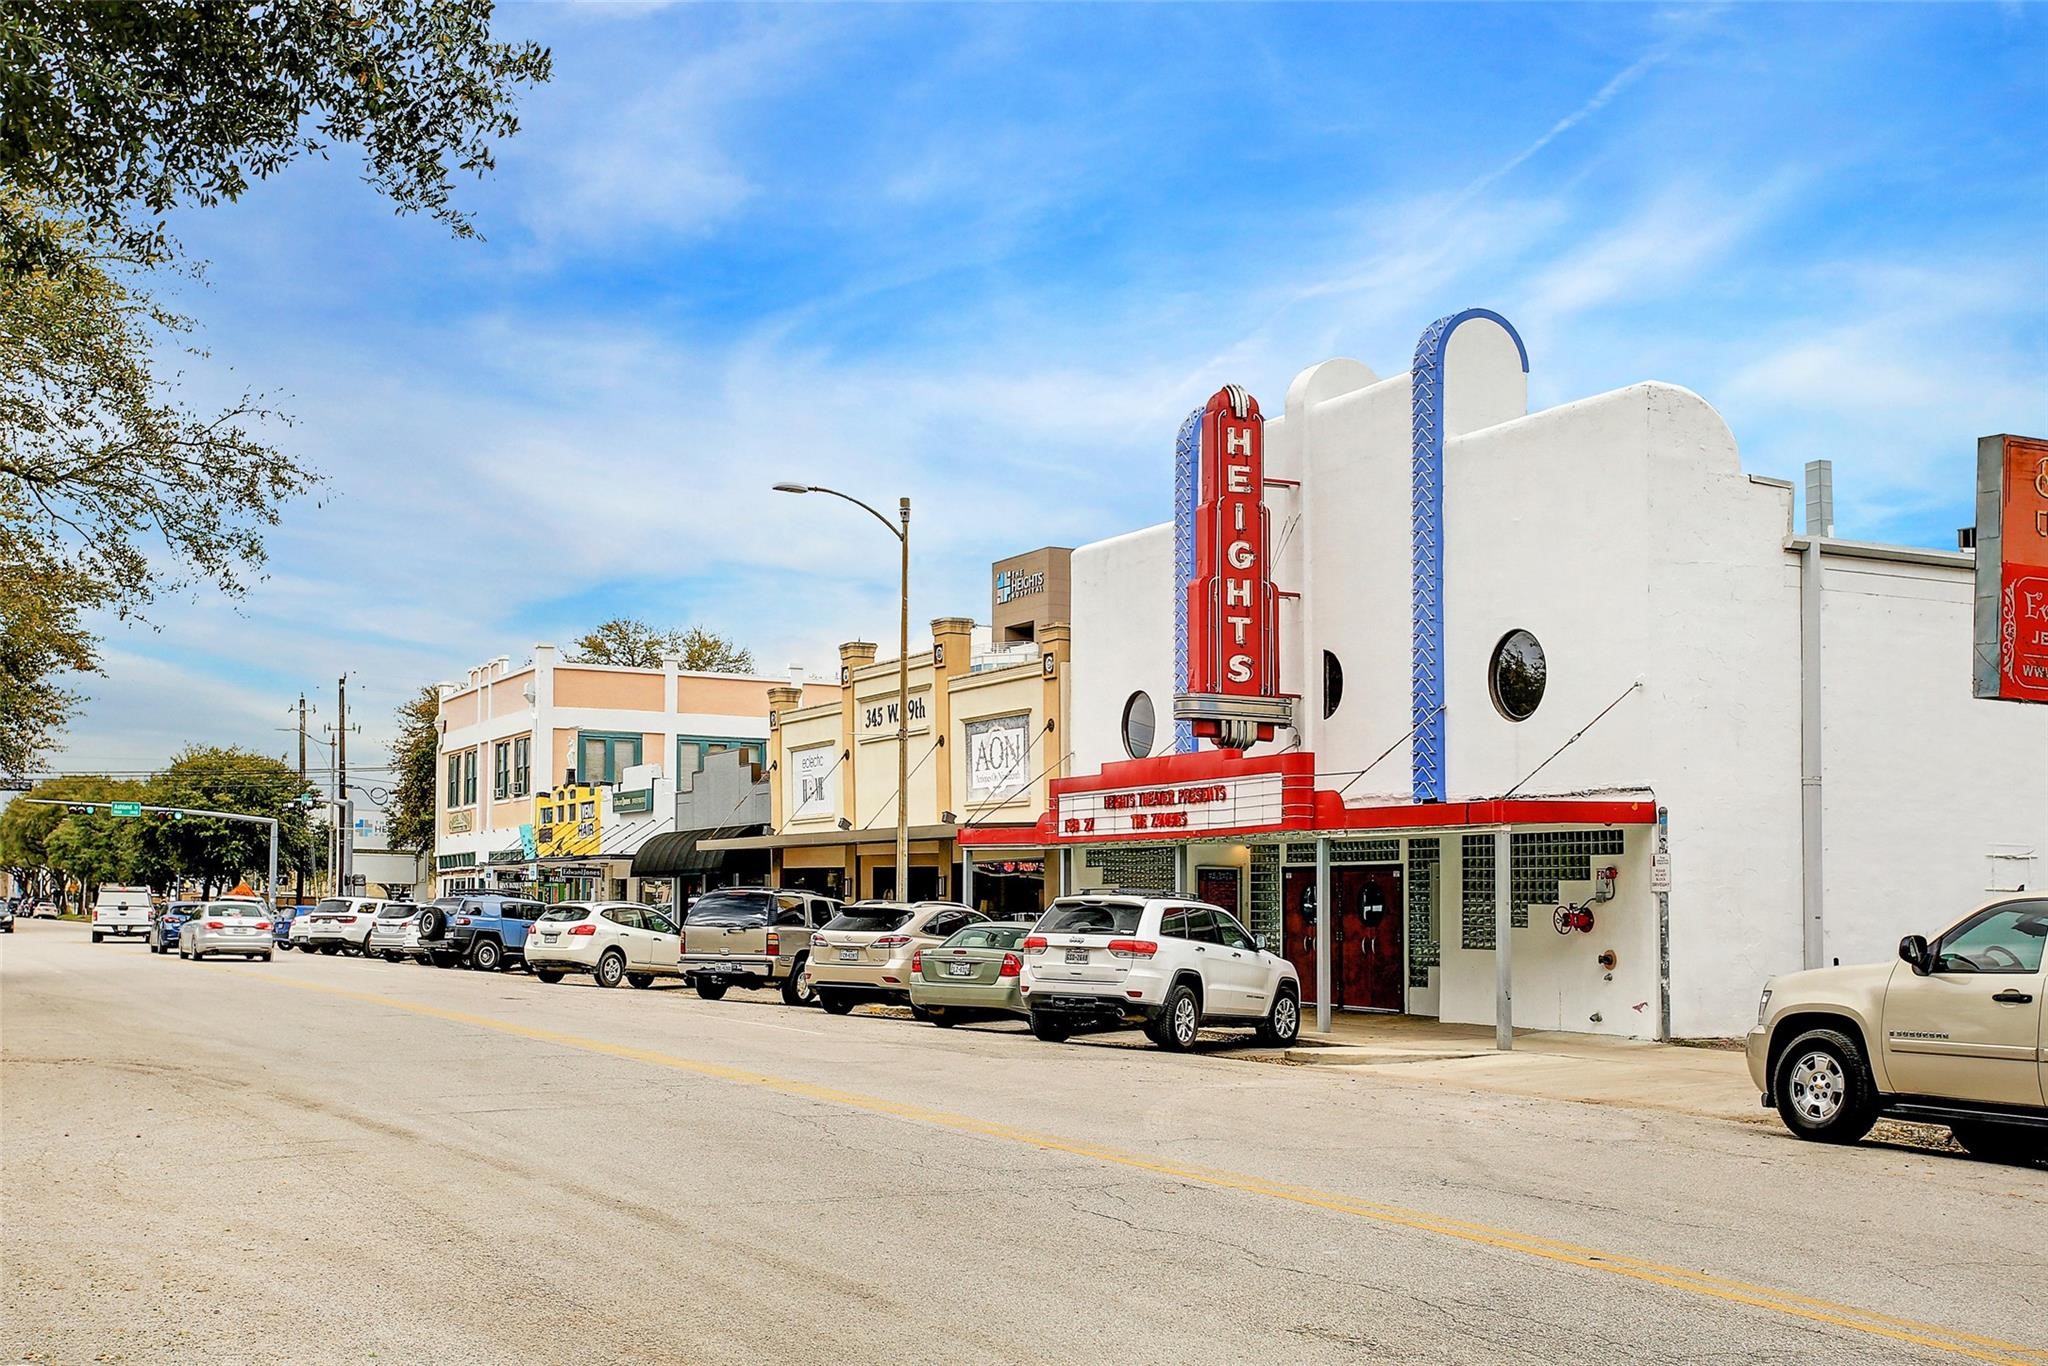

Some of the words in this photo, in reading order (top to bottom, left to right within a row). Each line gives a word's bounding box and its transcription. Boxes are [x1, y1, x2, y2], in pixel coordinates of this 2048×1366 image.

[1226, 426, 1255, 684] HEIGHTS
[1011, 568, 1024, 578] THE
[1011, 572, 1044, 592] HEIGHTS
[1011, 586, 1044, 600] HOSPITAL
[865, 707, 883, 728] 345
[887, 703, 899, 723] W.
[908, 697, 926, 720] 9th
[801, 754, 824, 769] eclectic
[975, 734, 1021, 772] AON
[1104, 793, 1136, 809] HEIGHTS
[1138, 790, 1174, 807] THEATER
[1178, 785, 1227, 804] PRESENTS
[1130, 814, 1147, 829] THE
